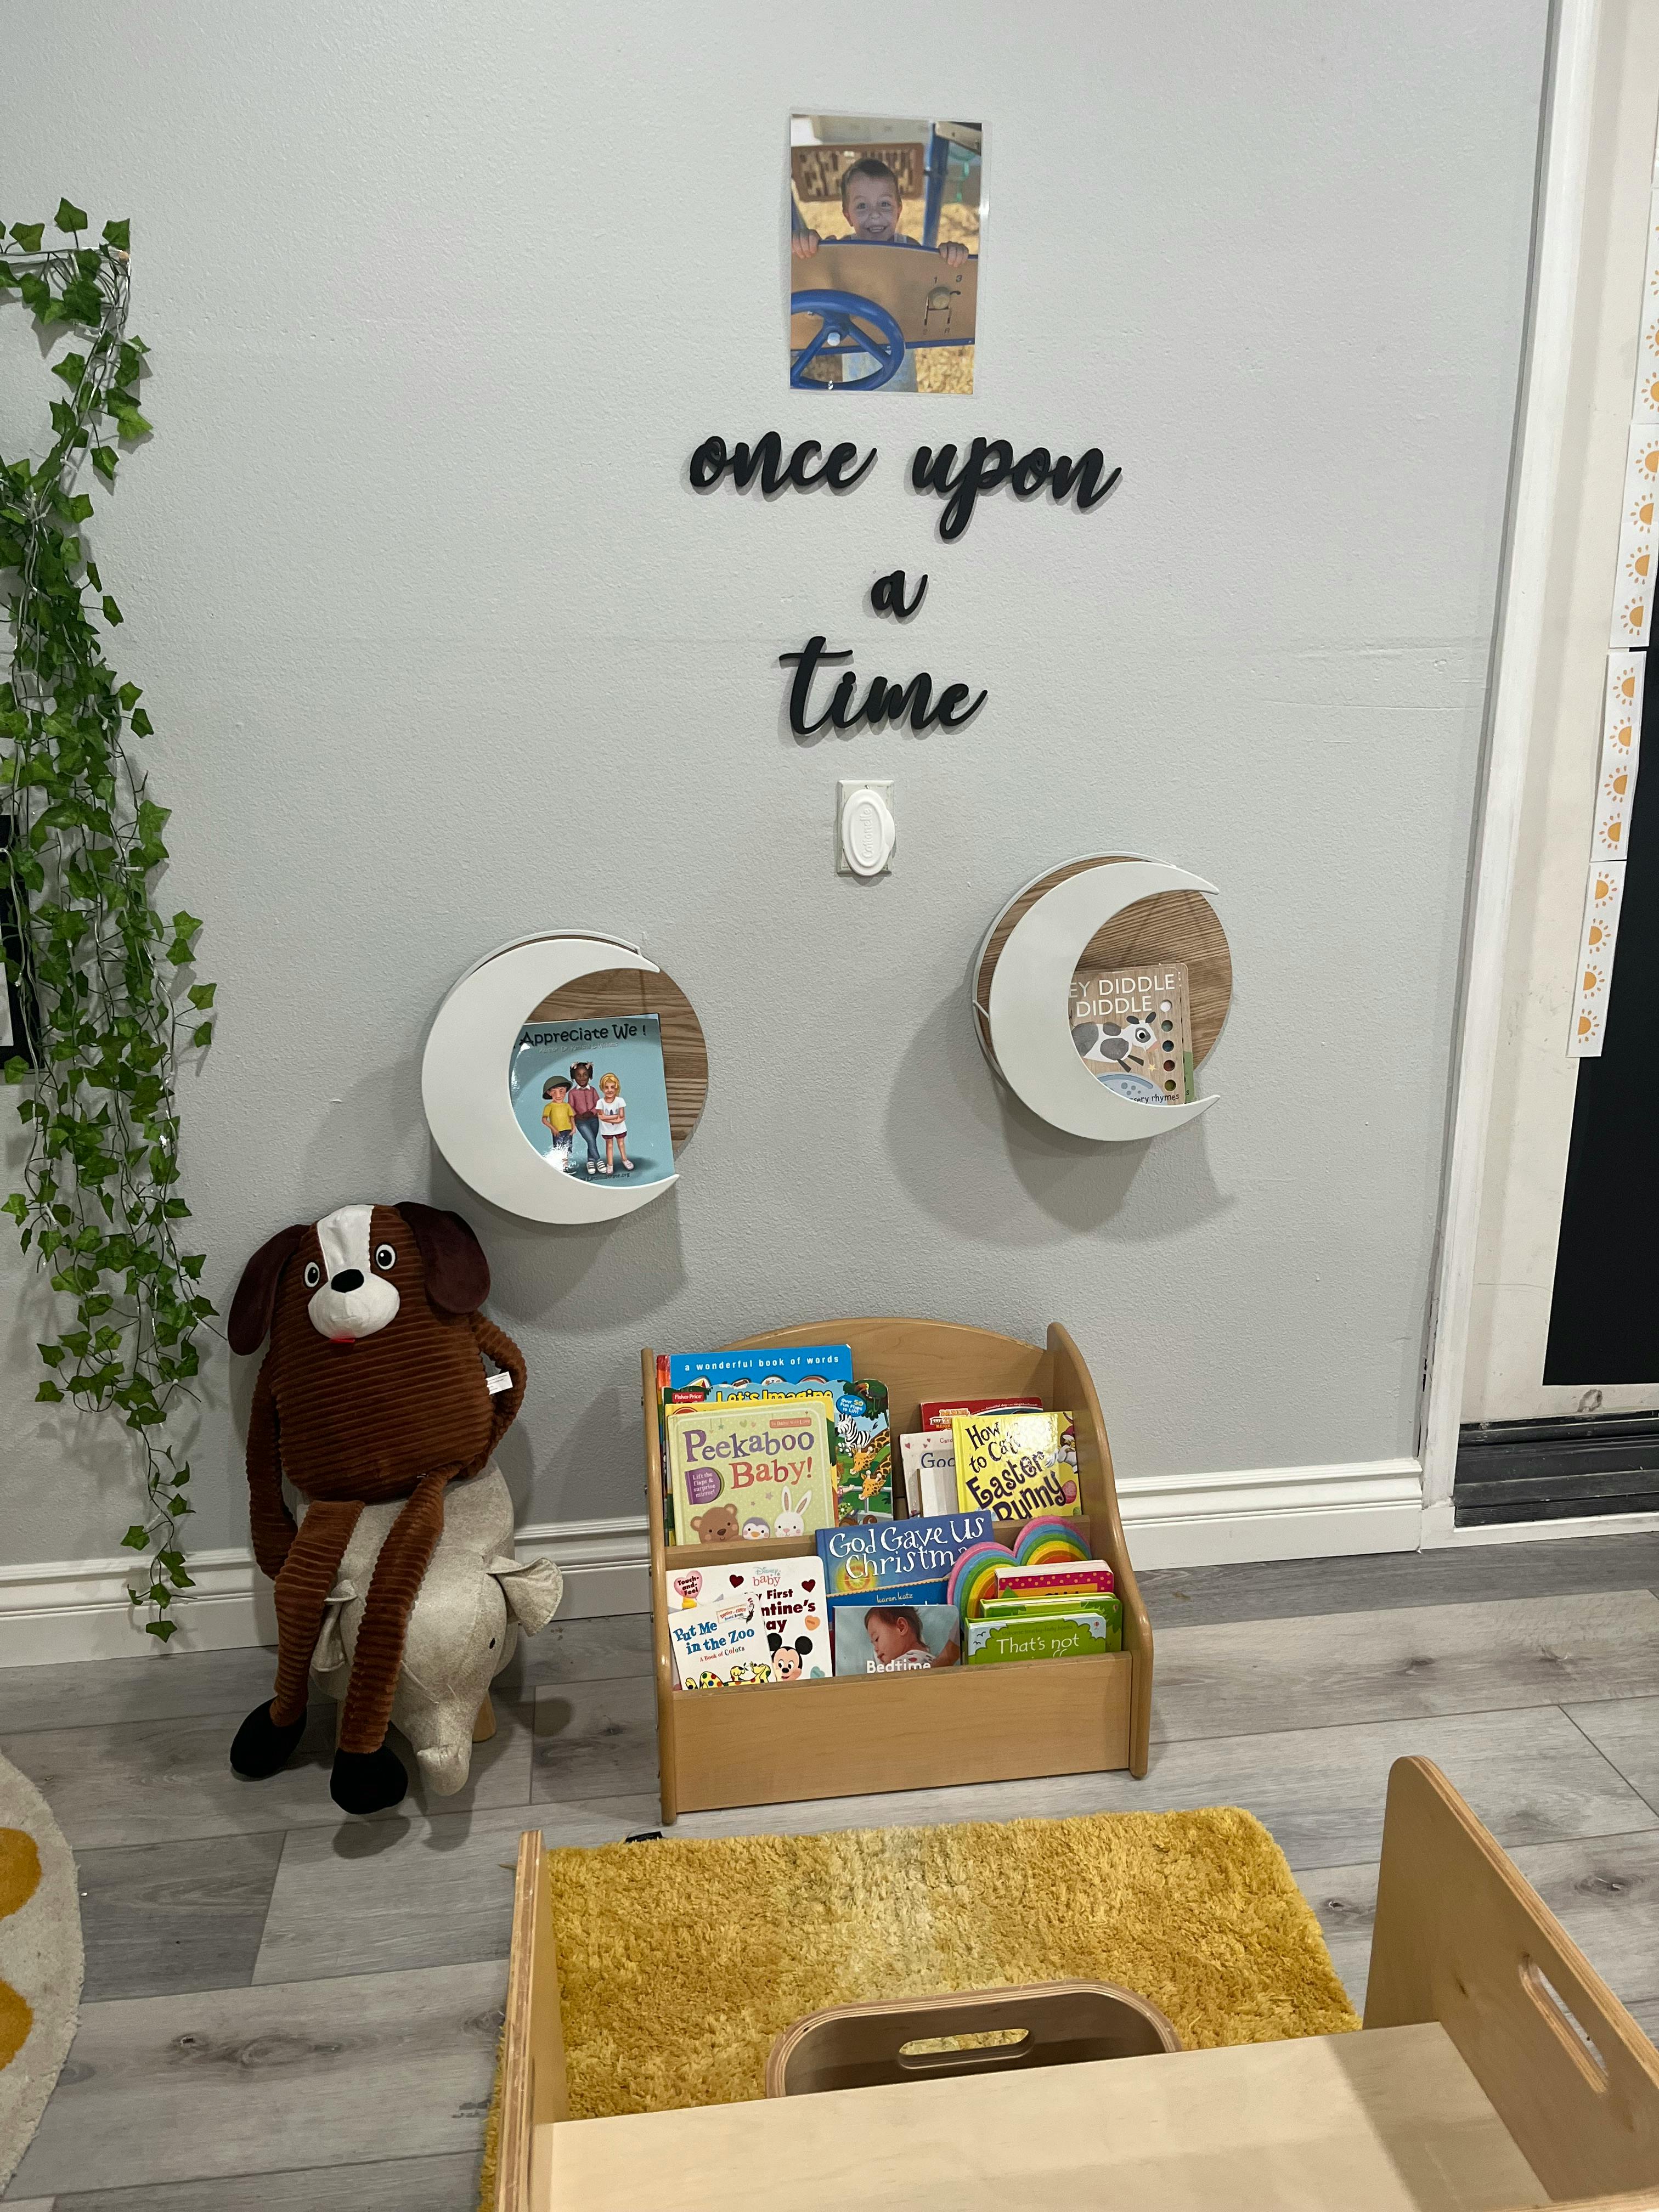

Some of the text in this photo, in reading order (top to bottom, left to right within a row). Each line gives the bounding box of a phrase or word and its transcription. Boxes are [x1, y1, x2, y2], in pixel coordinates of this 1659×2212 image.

[689, 431, 1122, 539] once upon
[871, 570, 928, 618] a
[778, 636, 988, 735] time
[1069, 974, 1176, 998] EY DIDDLE
[1076, 995, 1152, 1018] DIDDLE
[520, 1027, 609, 1047] Appreciate
[612, 1023, 637, 1040] We
[1151, 1093, 1180, 1103] rhymes
[696, 1359, 753, 1370] wonderful
[759, 1358, 785, 1367] book
[790, 1357, 801, 1365] of
[806, 1355, 839, 1364] words
[716, 1391, 760, 1402] Let's
[682, 1429, 815, 1463] Peekaboo
[965, 1422, 1000, 1451] How
[921, 1452, 956, 1468] Goo
[969, 1431, 1021, 1473] to Cat
[729, 1456, 812, 1489] Baby!
[966, 1451, 1045, 1510] Easter
[693, 1484, 716, 1492] surprise
[992, 1470, 1066, 1521] Bunny
[829, 1528, 876, 1558] God
[880, 1527, 948, 1551] Gave
[845, 1544, 967, 1579] Christm
[677, 1576, 699, 1586] Touch-
[682, 1582, 698, 1590] and-
[684, 1587, 698, 1596] Feel
[752, 1575, 781, 1587] baby
[766, 1589, 793, 1600] First
[876, 1595, 897, 1604] karen
[898, 1592, 913, 1600] katz
[761, 1599, 816, 1617] ntine's
[673, 1621, 718, 1642] Put Me
[763, 1620, 787, 1633] ay
[686, 1629, 755, 1655] in the Zoo
[724, 1646, 745, 1656] Colors
[996, 1637, 1045, 1654] That's
[1052, 1633, 1080, 1650] not
[867, 1658, 931, 1674] Bedtime
